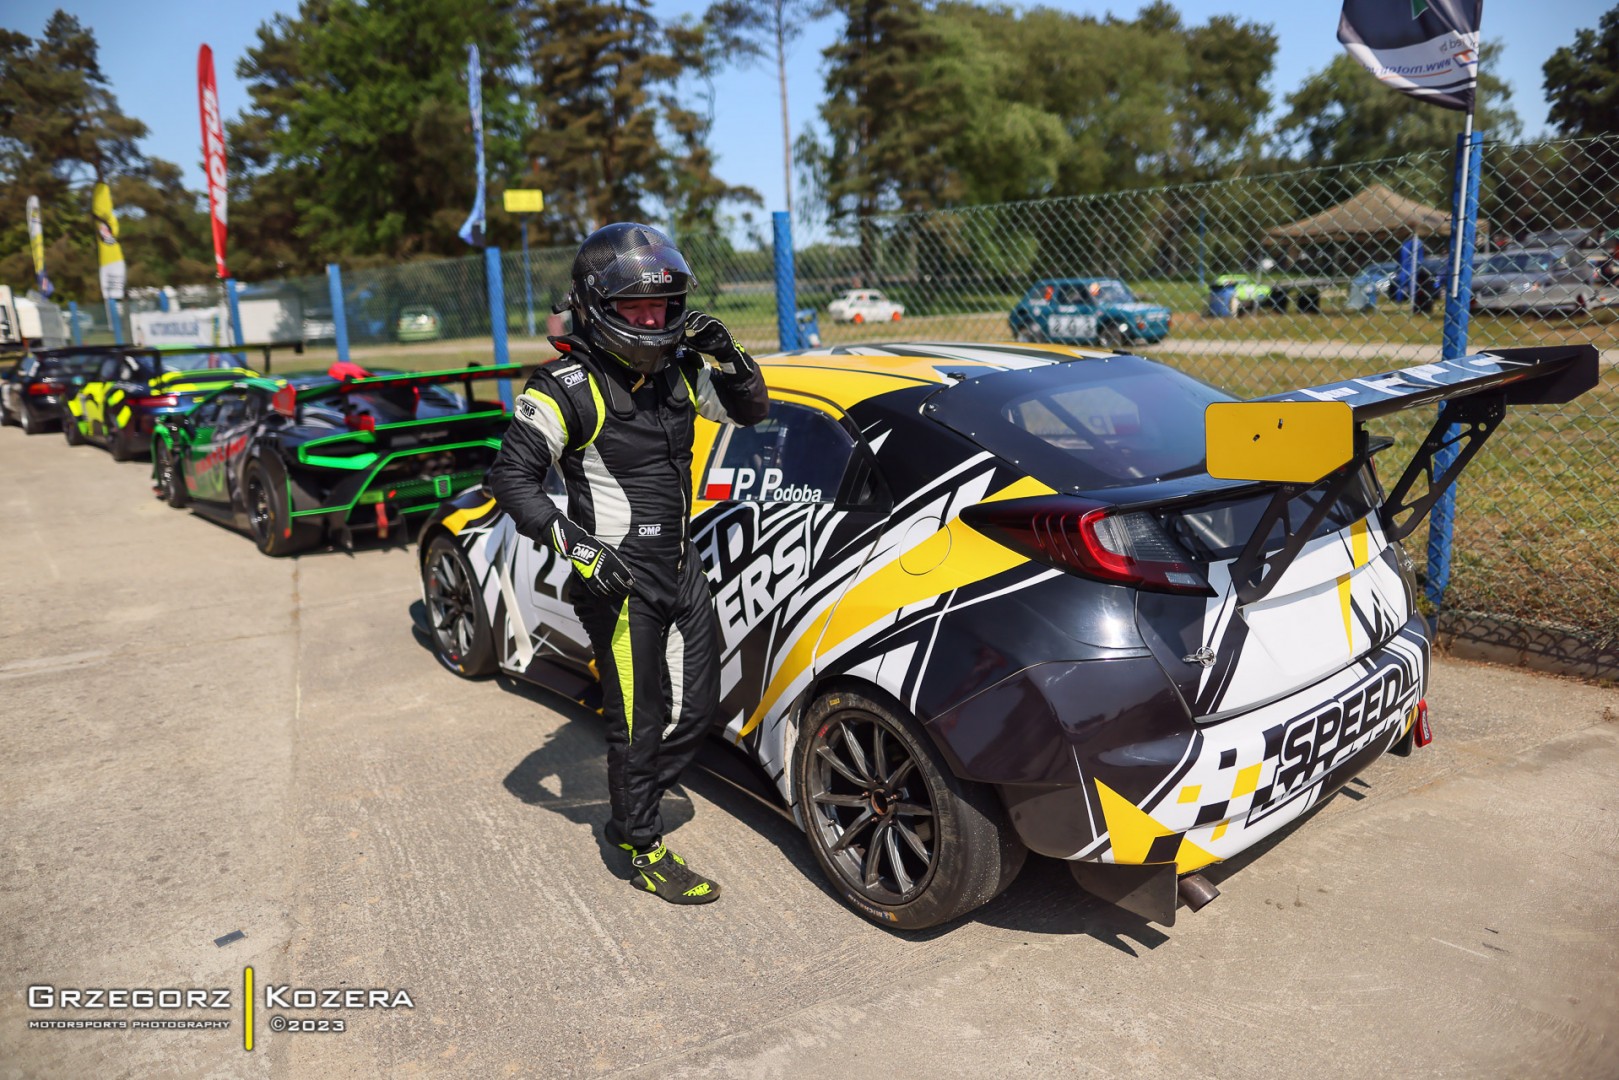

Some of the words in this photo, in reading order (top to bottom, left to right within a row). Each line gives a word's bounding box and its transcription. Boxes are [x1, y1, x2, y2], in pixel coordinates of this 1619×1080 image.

[641, 268, 673, 284] Stilo
[564, 371, 584, 386] OMP
[733, 468, 756, 501] P.
[760, 468, 822, 503] Podoba
[638, 526, 661, 536] OMP
[572, 545, 596, 561] OMP
[1284, 668, 1401, 763] SPEED
[687, 883, 711, 897] OMP
